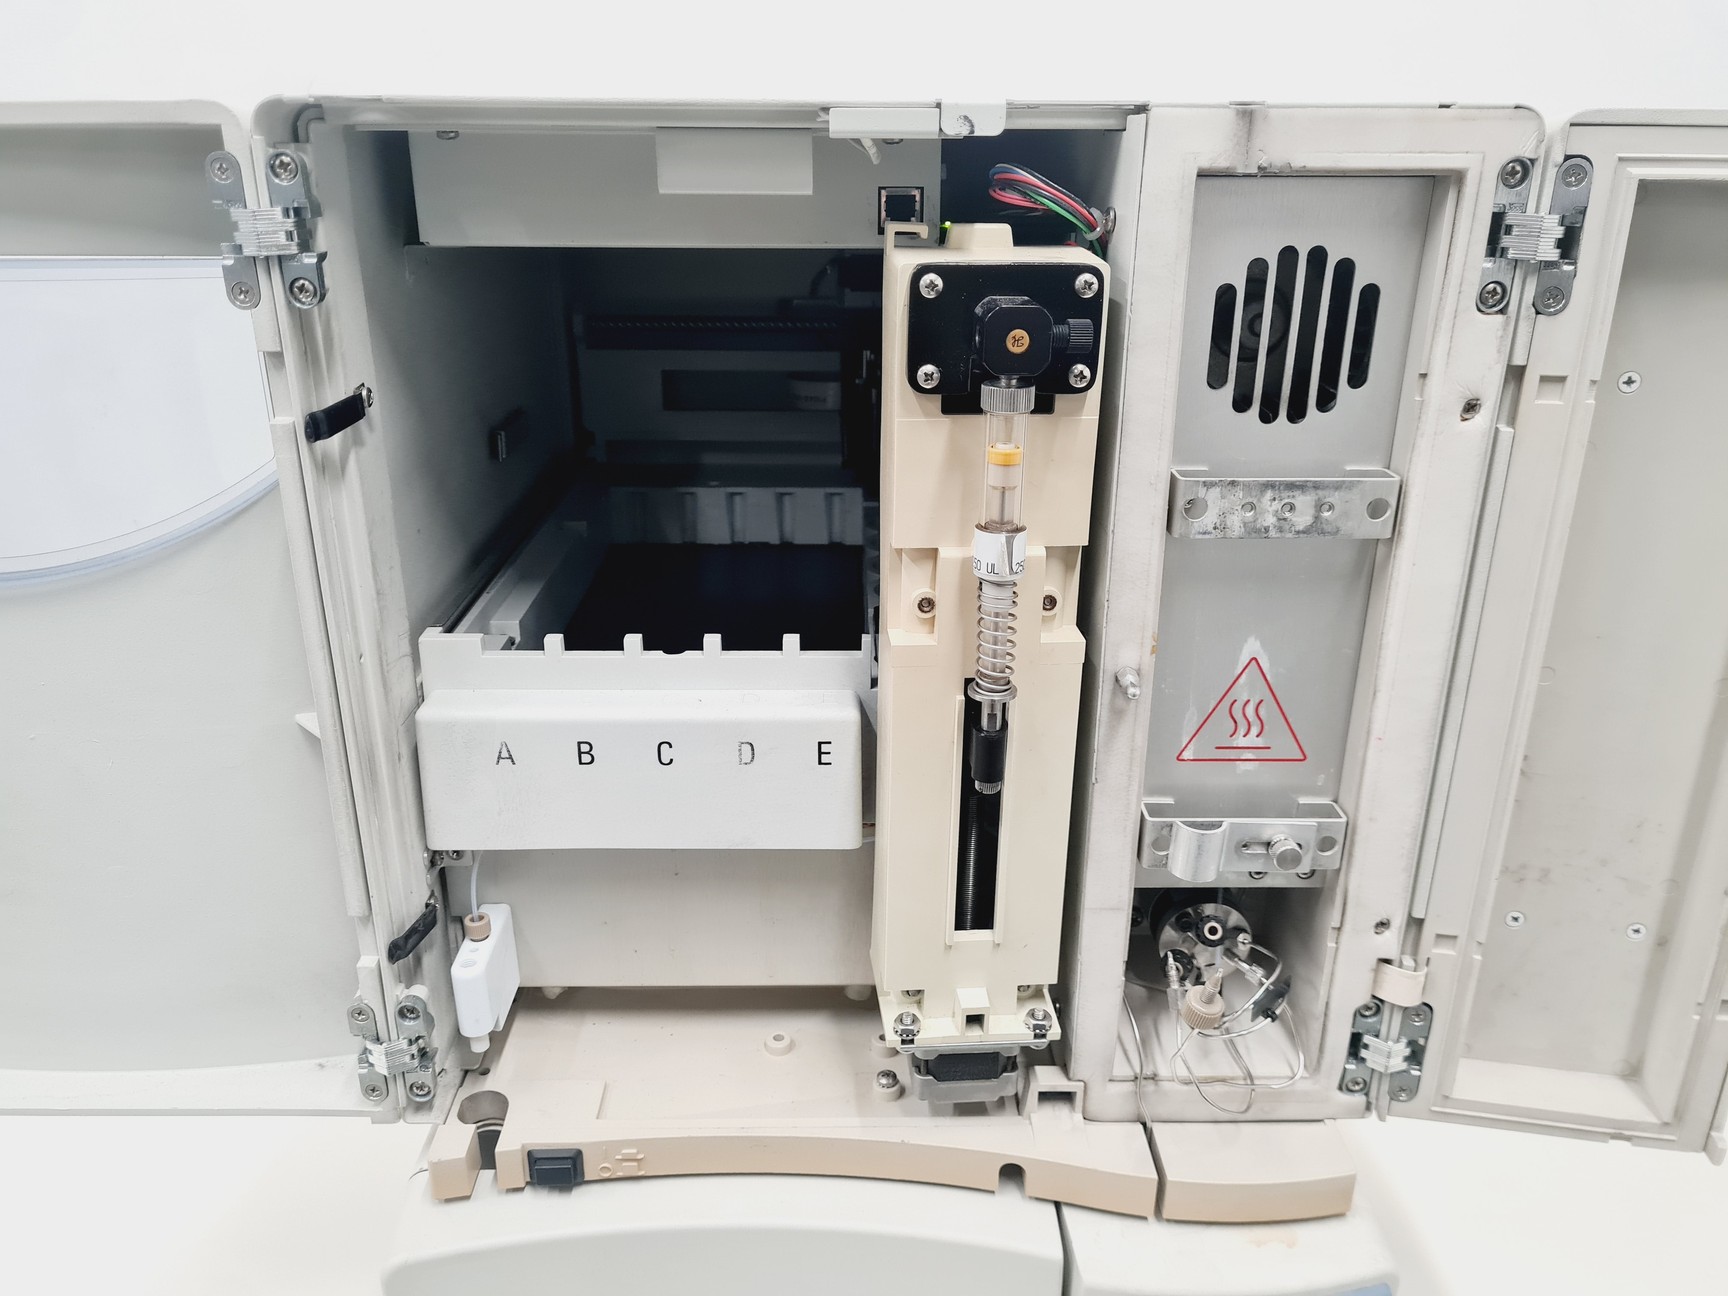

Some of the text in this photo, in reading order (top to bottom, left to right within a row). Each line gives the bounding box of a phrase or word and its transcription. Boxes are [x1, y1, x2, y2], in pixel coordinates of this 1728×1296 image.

[972, 556, 1025, 575] 50 UL 25
[495, 741, 833, 766] A B C D E
